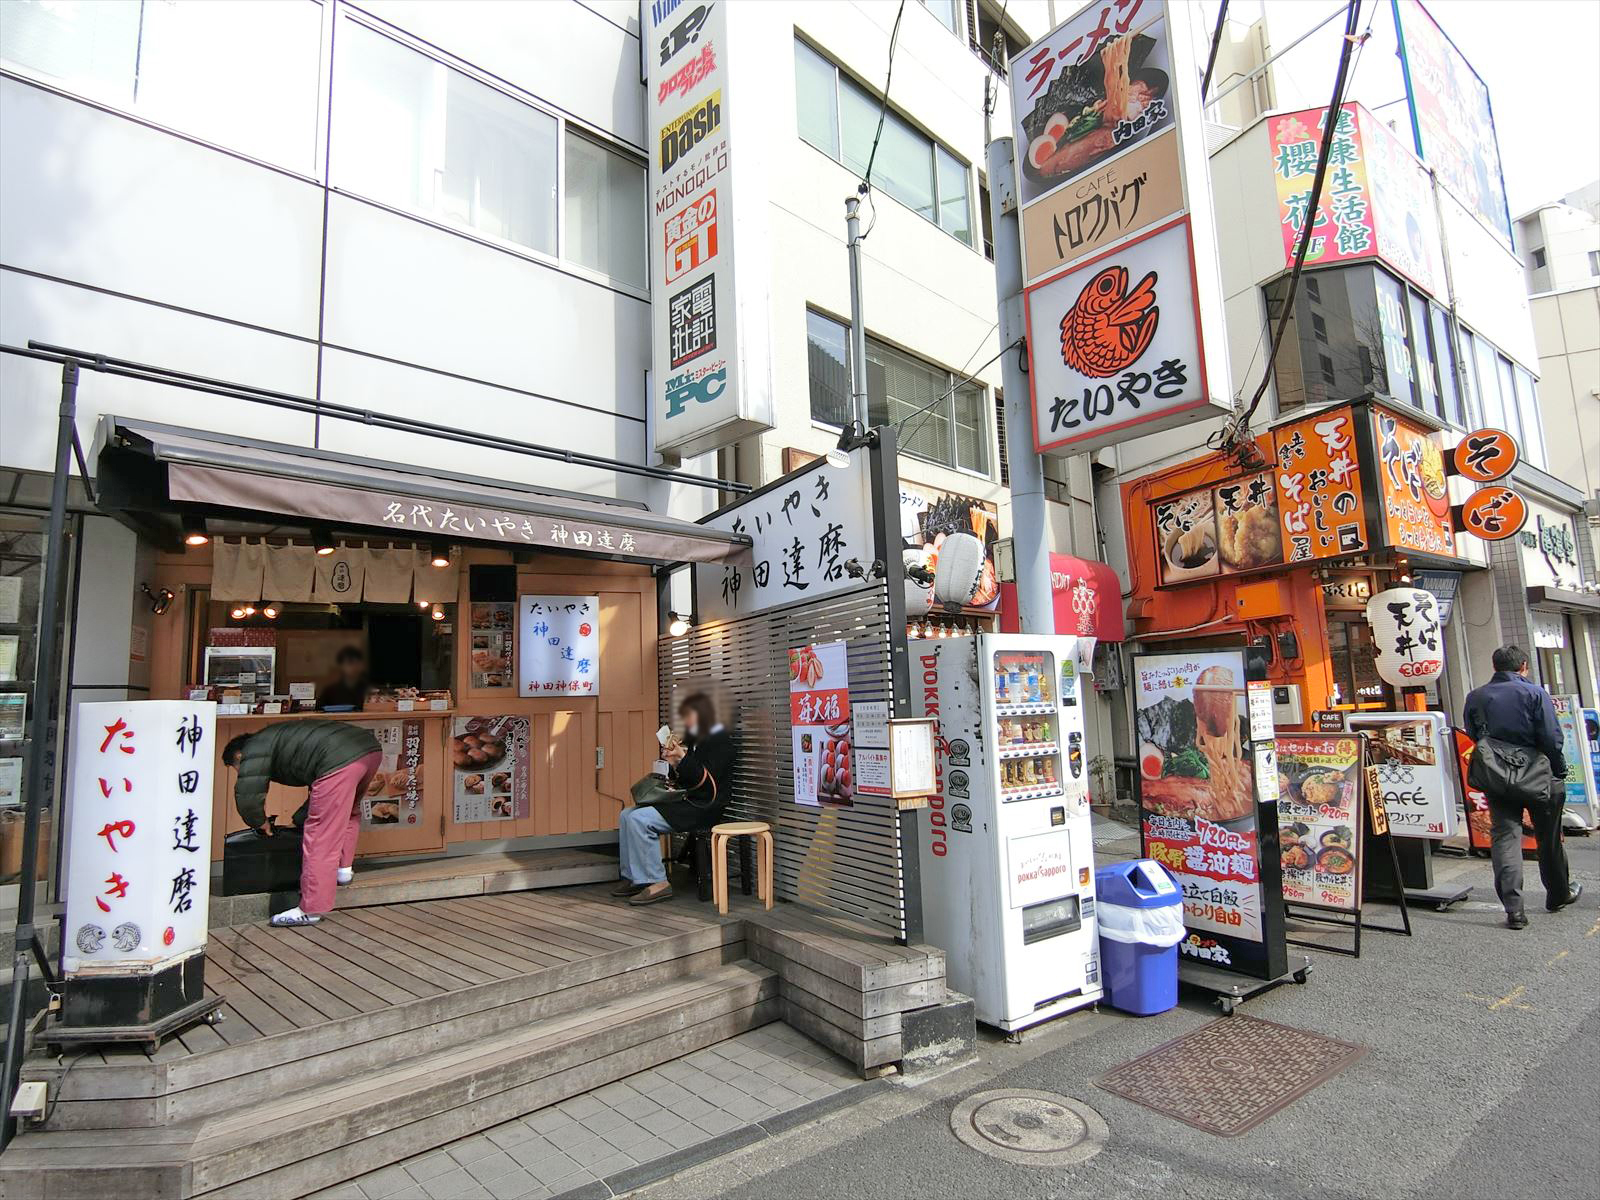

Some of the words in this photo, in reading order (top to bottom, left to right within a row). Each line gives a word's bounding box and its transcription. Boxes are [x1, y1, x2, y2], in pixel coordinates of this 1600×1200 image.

[1025, 0, 1143, 100] ラーメン
[1112, 101, 1167, 144] 内田家
[656, 152, 728, 217] MONOQLO
[665, 194, 716, 247] 黄金の
[1053, 172, 1148, 259] トロワバグ
[665, 222, 716, 283] GT
[671, 279, 714, 328] 家電
[665, 367, 726, 420] PC
[1049, 358, 1188, 433] たいやき
[1157, 503, 1200, 533] そば
[1218, 474, 1273, 517] 天丼
[382, 501, 535, 541] 名代たいやき
[549, 524, 639, 553] 神田達磨
[721, 522, 848, 610] 神田達磨
[529, 602, 592, 617] たいやき
[1386, 602, 1419, 662] 天丼
[532, 621, 592, 675] 神田達磨
[527, 680, 594, 693] 神田神保町
[96, 716, 137, 913] たいやき
[169, 714, 203, 914] 神田達磨
[1381, 786, 1429, 806] AFÉ
